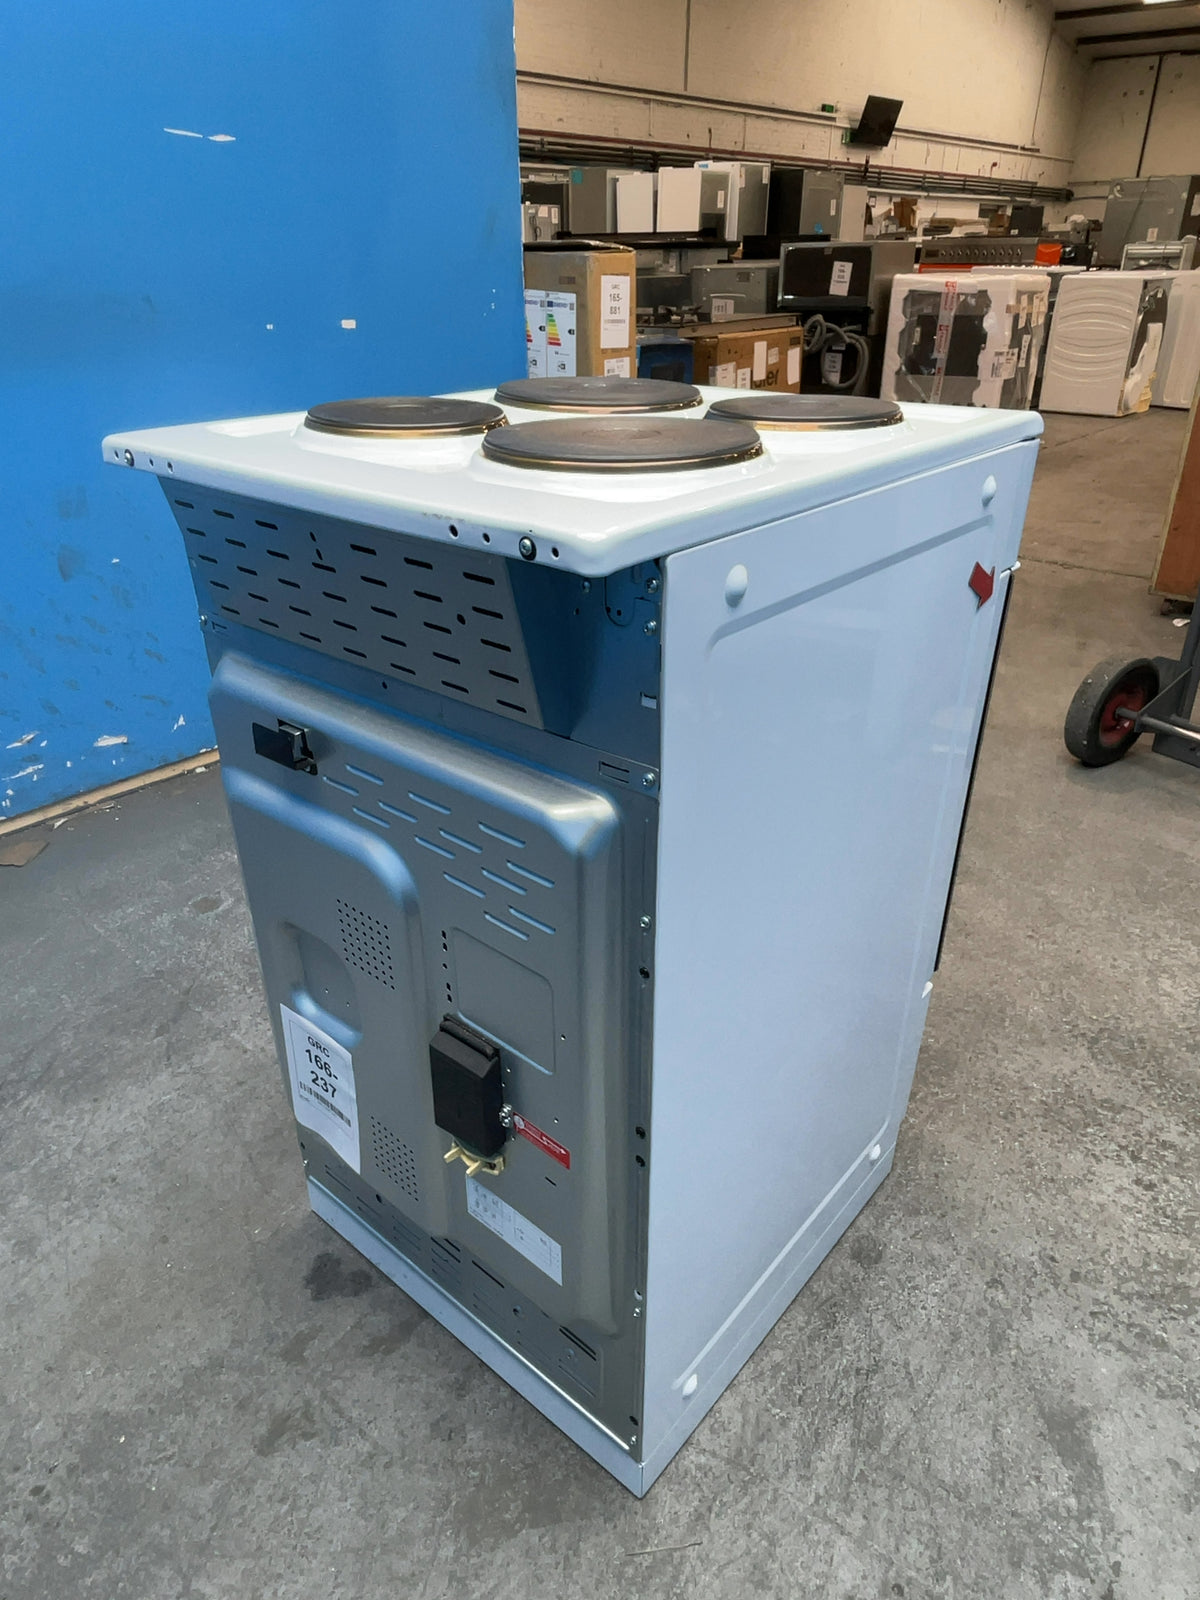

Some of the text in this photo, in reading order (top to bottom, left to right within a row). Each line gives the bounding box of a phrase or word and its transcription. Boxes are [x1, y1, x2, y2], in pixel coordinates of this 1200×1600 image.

[307, 1036, 330, 1058] GRC
[305, 1049, 338, 1080] 166-
[310, 1070, 337, 1098] 237
